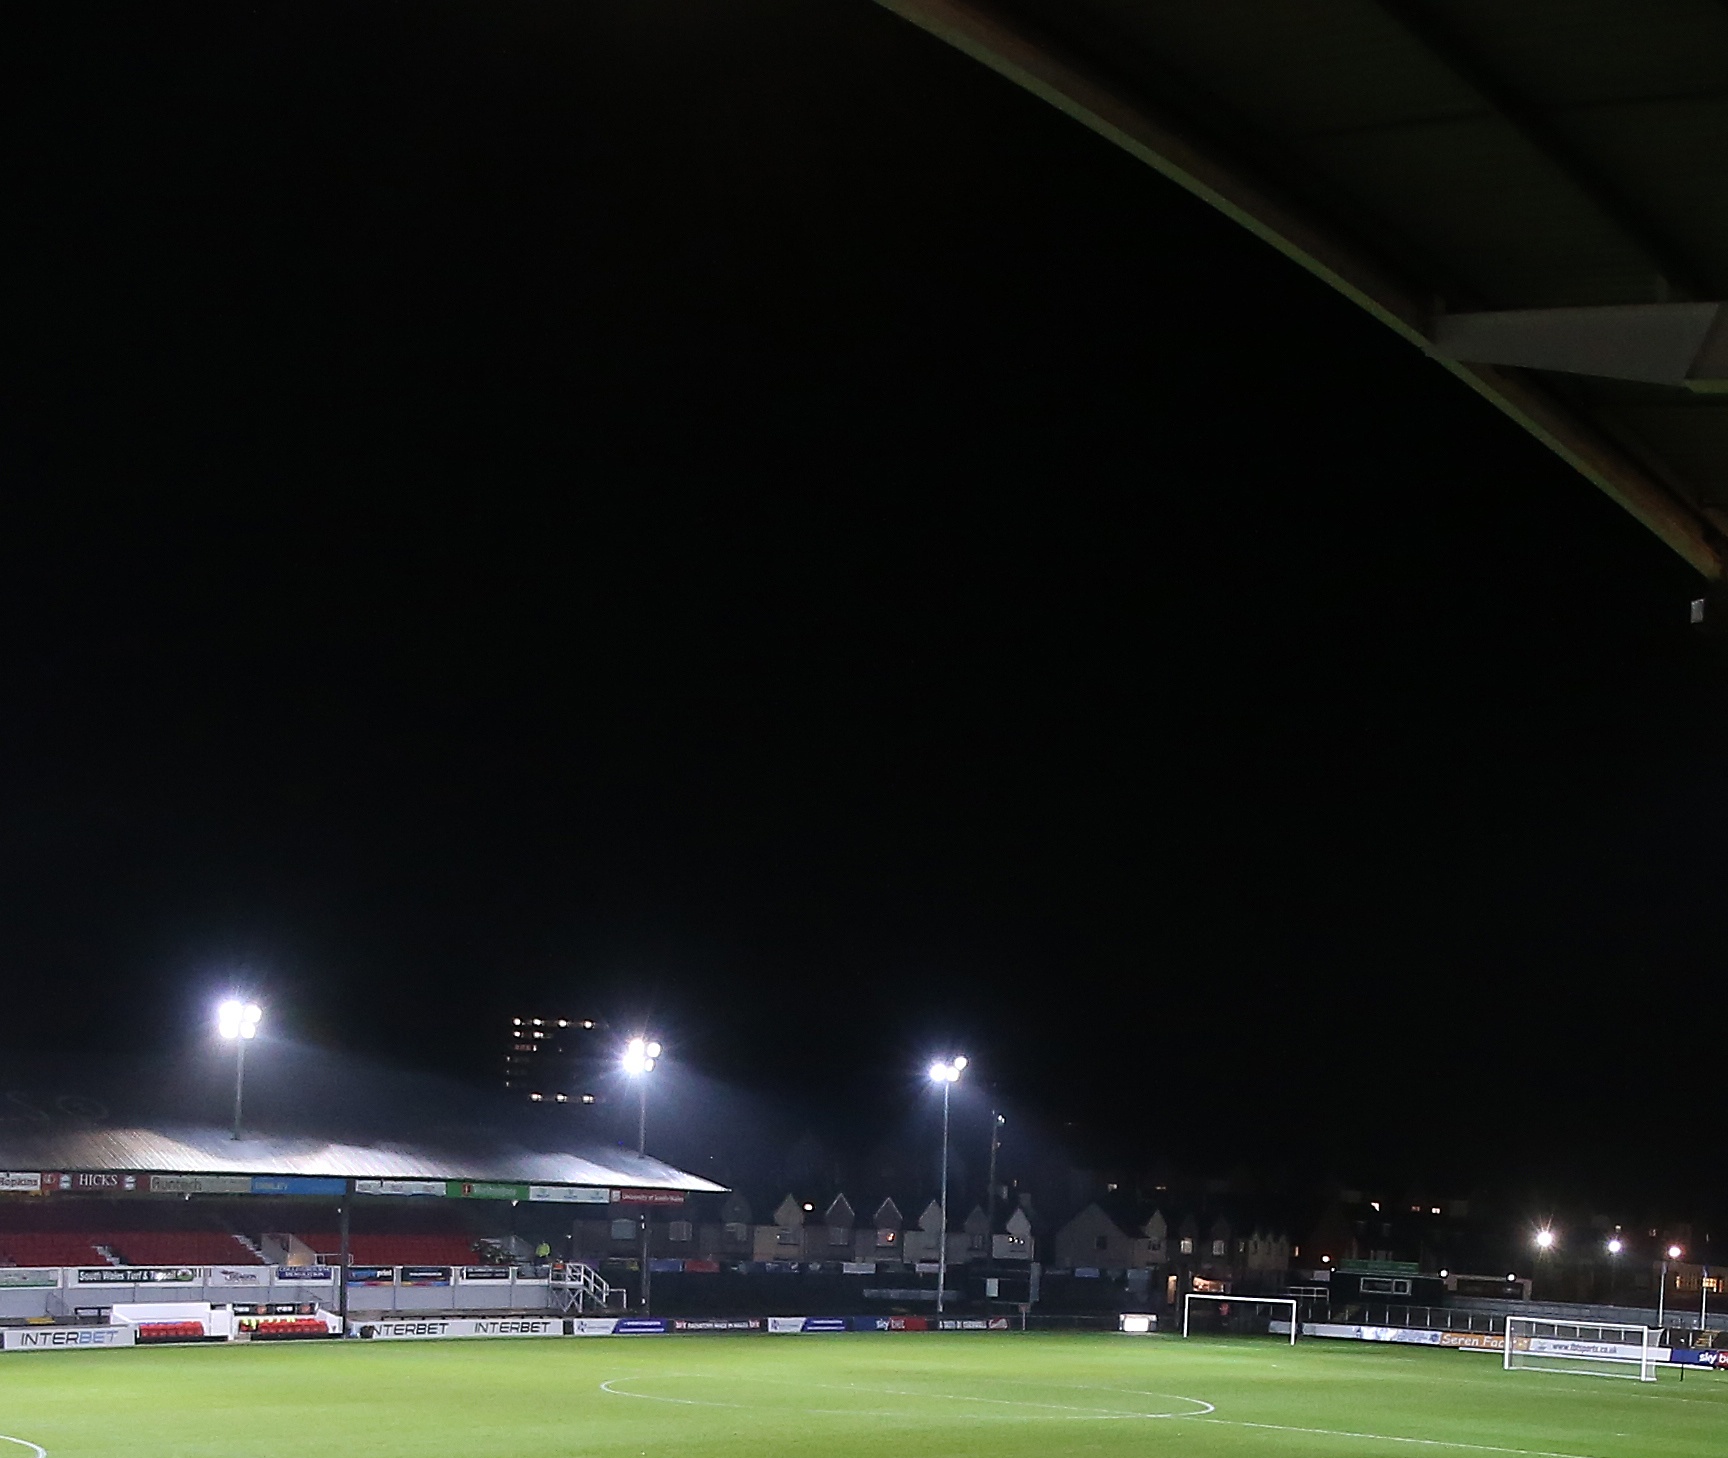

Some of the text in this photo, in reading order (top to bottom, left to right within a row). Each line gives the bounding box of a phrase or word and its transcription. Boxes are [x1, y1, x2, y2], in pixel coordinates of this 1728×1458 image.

[79, 1174, 118, 1186] HICKS
[79, 1270, 100, 1282] South
[103, 1270, 125, 1281] Wales
[127, 1270, 141, 1280] Turf
[142, 1271, 149, 1280] &
[372, 1324, 449, 1336] NTERBET
[474, 1322, 550, 1334] INTERBET
[876, 1318, 905, 1331] sky bet
[21, 1330, 119, 1346] INTERBET
[1442, 1333, 1479, 1346] Seren
[1699, 1351, 1717, 1364] sky
